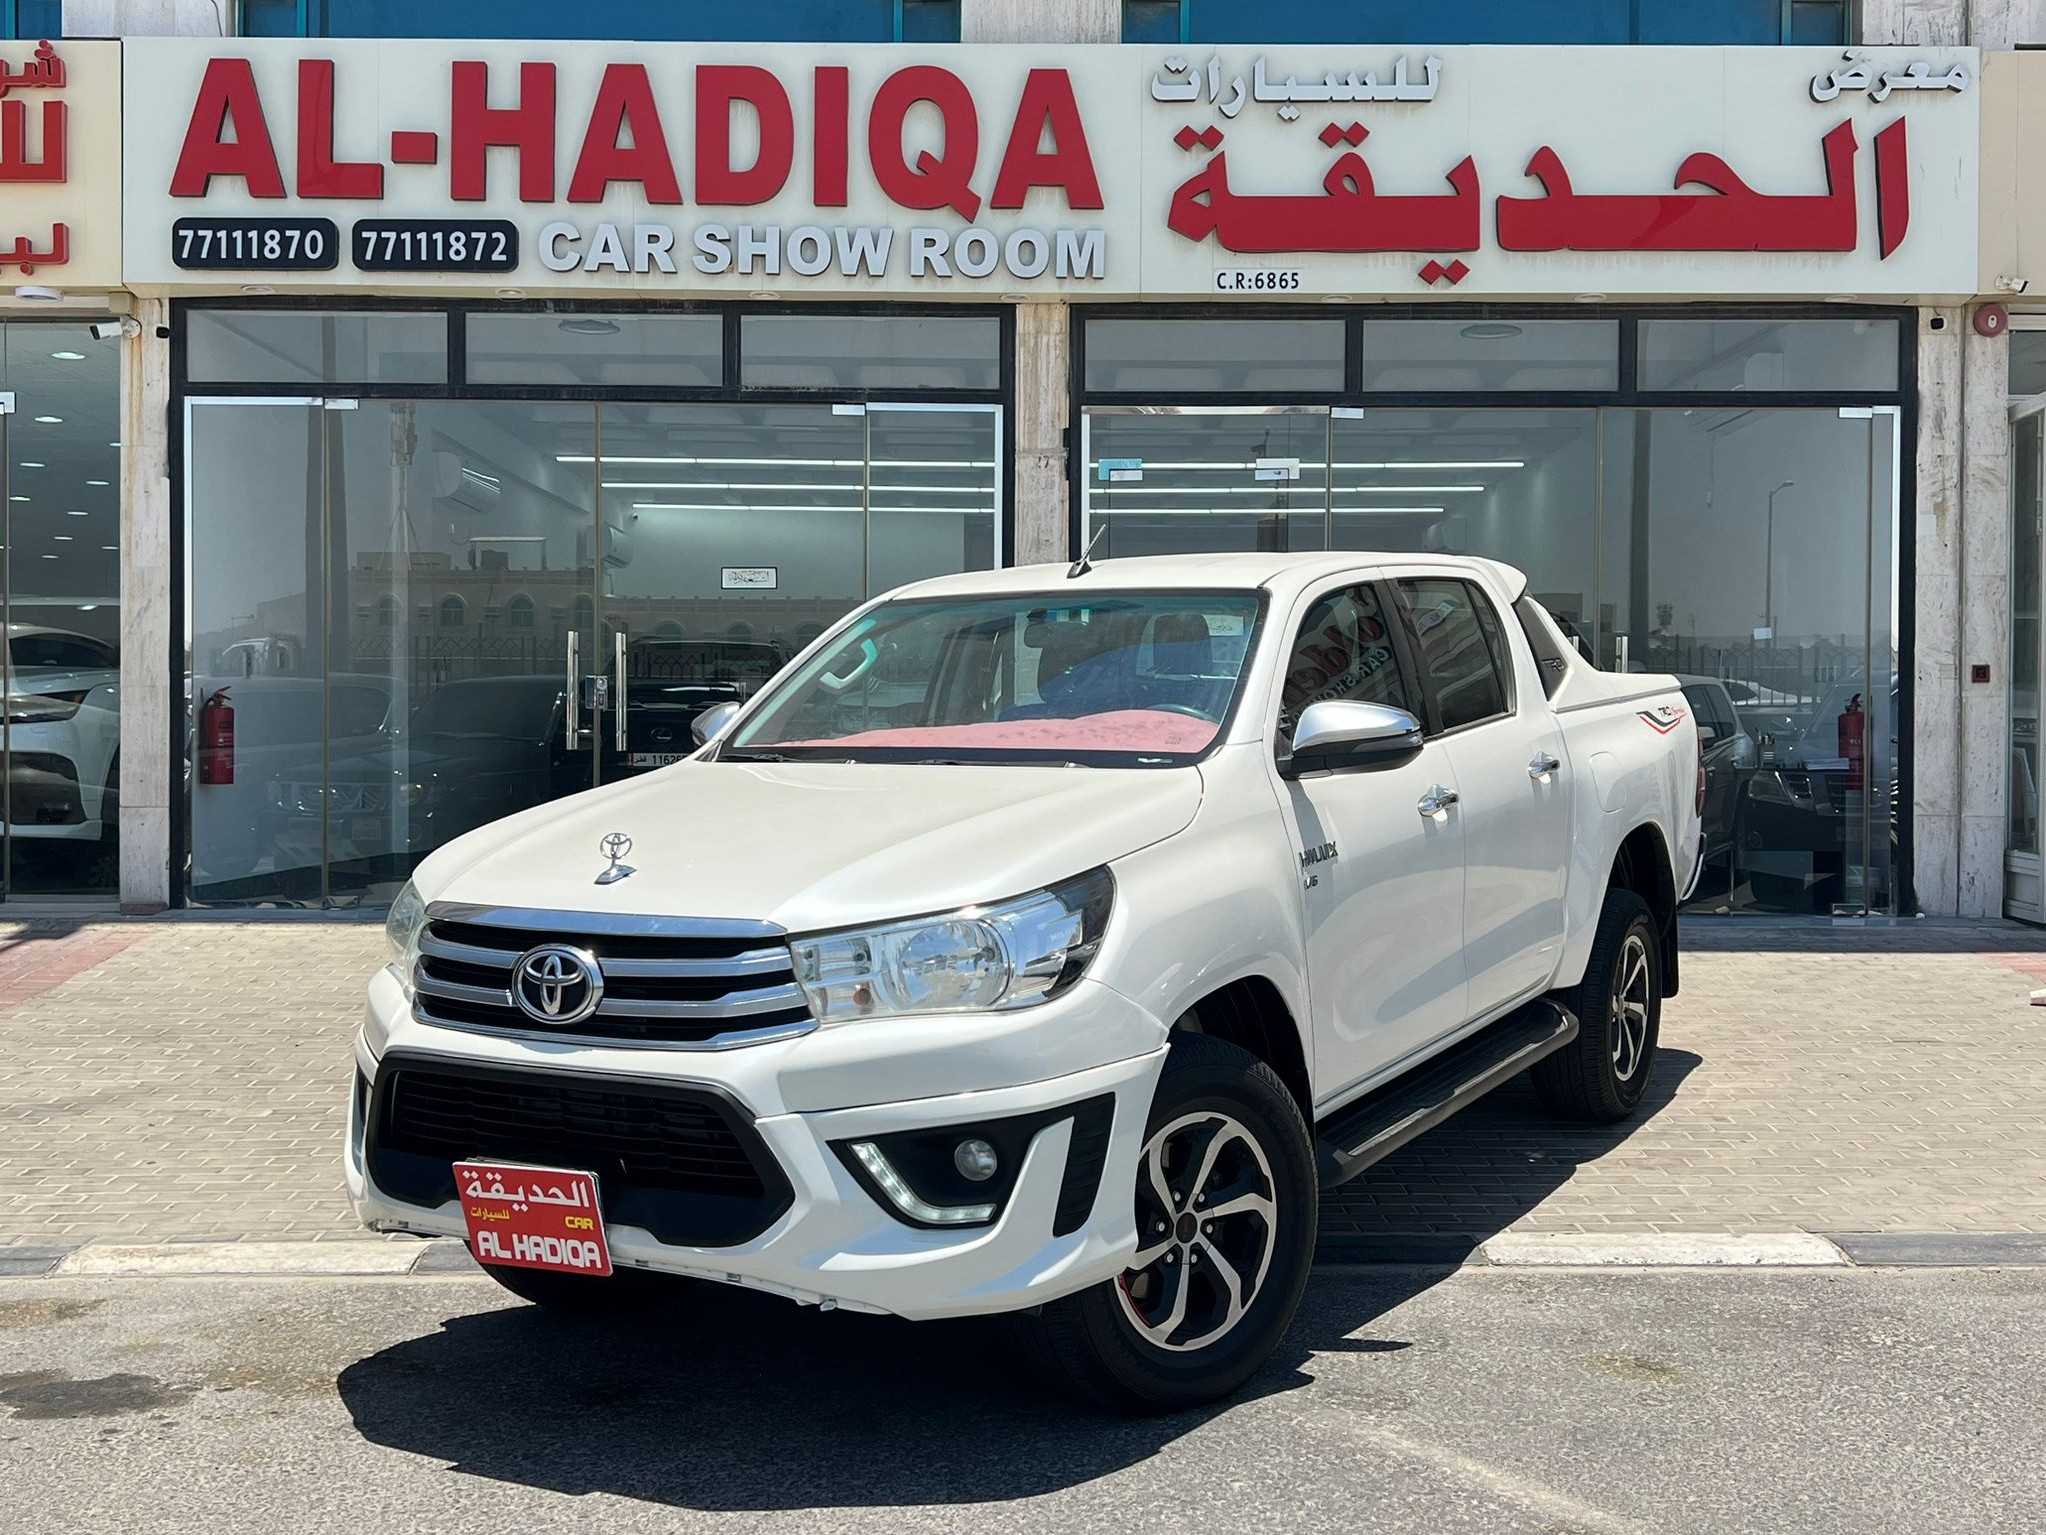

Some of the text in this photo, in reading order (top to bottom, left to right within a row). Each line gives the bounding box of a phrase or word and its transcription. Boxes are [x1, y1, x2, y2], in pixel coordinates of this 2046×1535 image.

[1152, 55, 1443, 122] للسيارات
[1809, 50, 1969, 104] معرض
[169, 57, 1105, 223] AL-HADIQA
[1167, 115, 1910, 285] الحديقة
[178, 229, 324, 260] 77111870
[361, 231, 507, 262] 77111872
[538, 222, 1105, 280] CAR SHOW ROOM
[1216, 272, 1300, 290] C.R:6865
[652, 754, 690, 765] 1162
[462, 1170, 590, 1212] الحديقة
[469, 1206, 511, 1222] للسيارات
[564, 1215, 595, 1231] CAR
[511, 1233, 603, 1269] HADIQA
